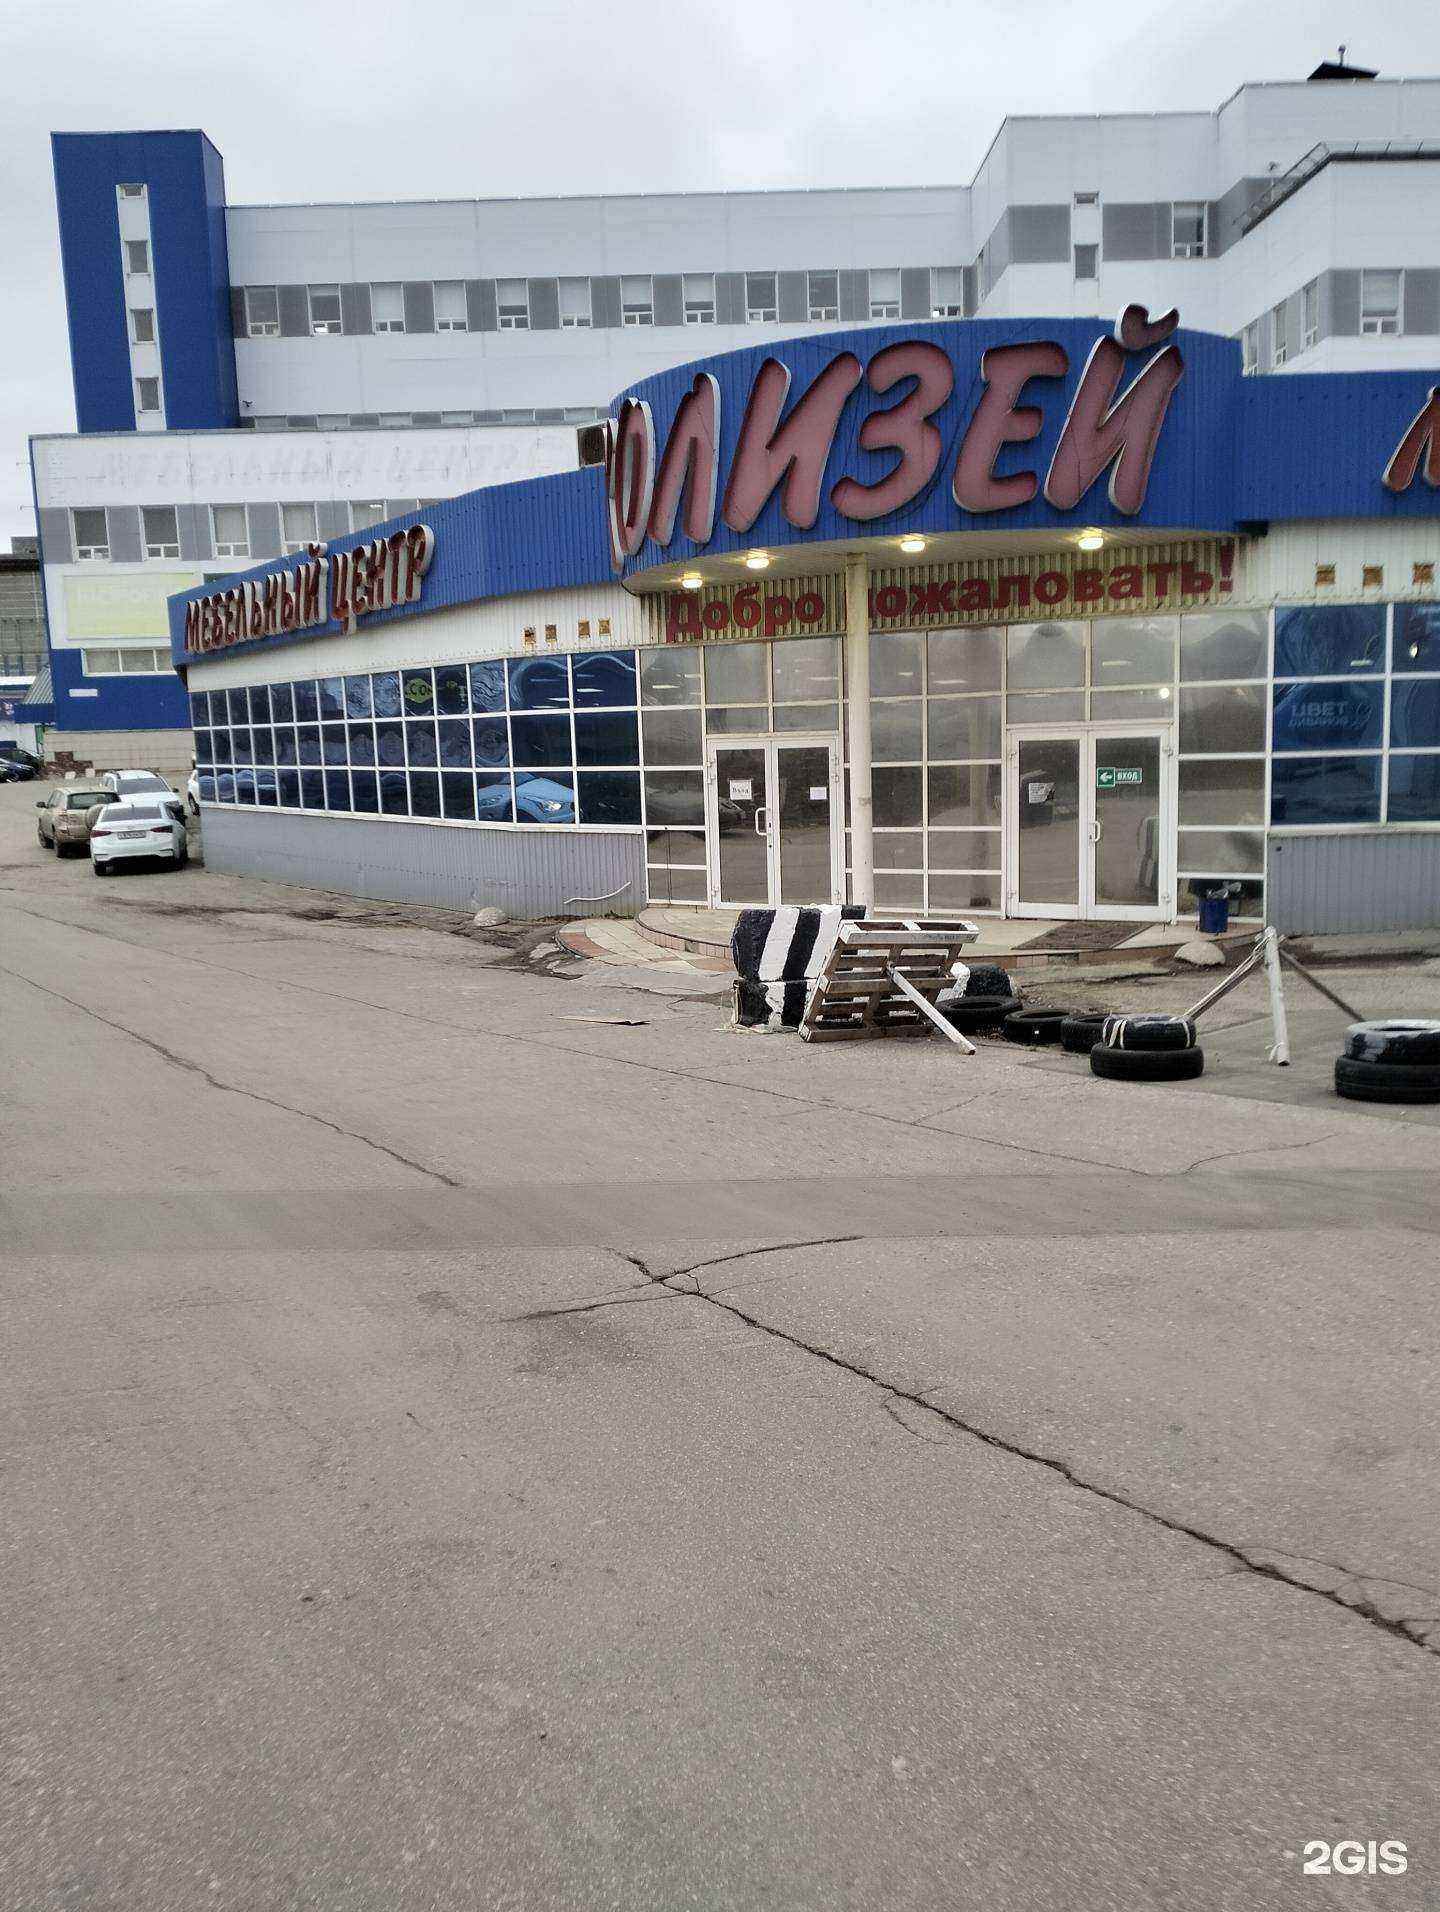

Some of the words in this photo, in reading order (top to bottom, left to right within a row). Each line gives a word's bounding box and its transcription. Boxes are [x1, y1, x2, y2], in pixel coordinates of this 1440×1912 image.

[185, 542, 329, 653] МЕБЕЛЬНЫЙ
[332, 524, 435, 635] ЦЕНТР
[666, 586, 825, 643] Добро
[846, 545, 1234, 618] ожаловать!
[1117, 772, 1138, 781] ВХОД
